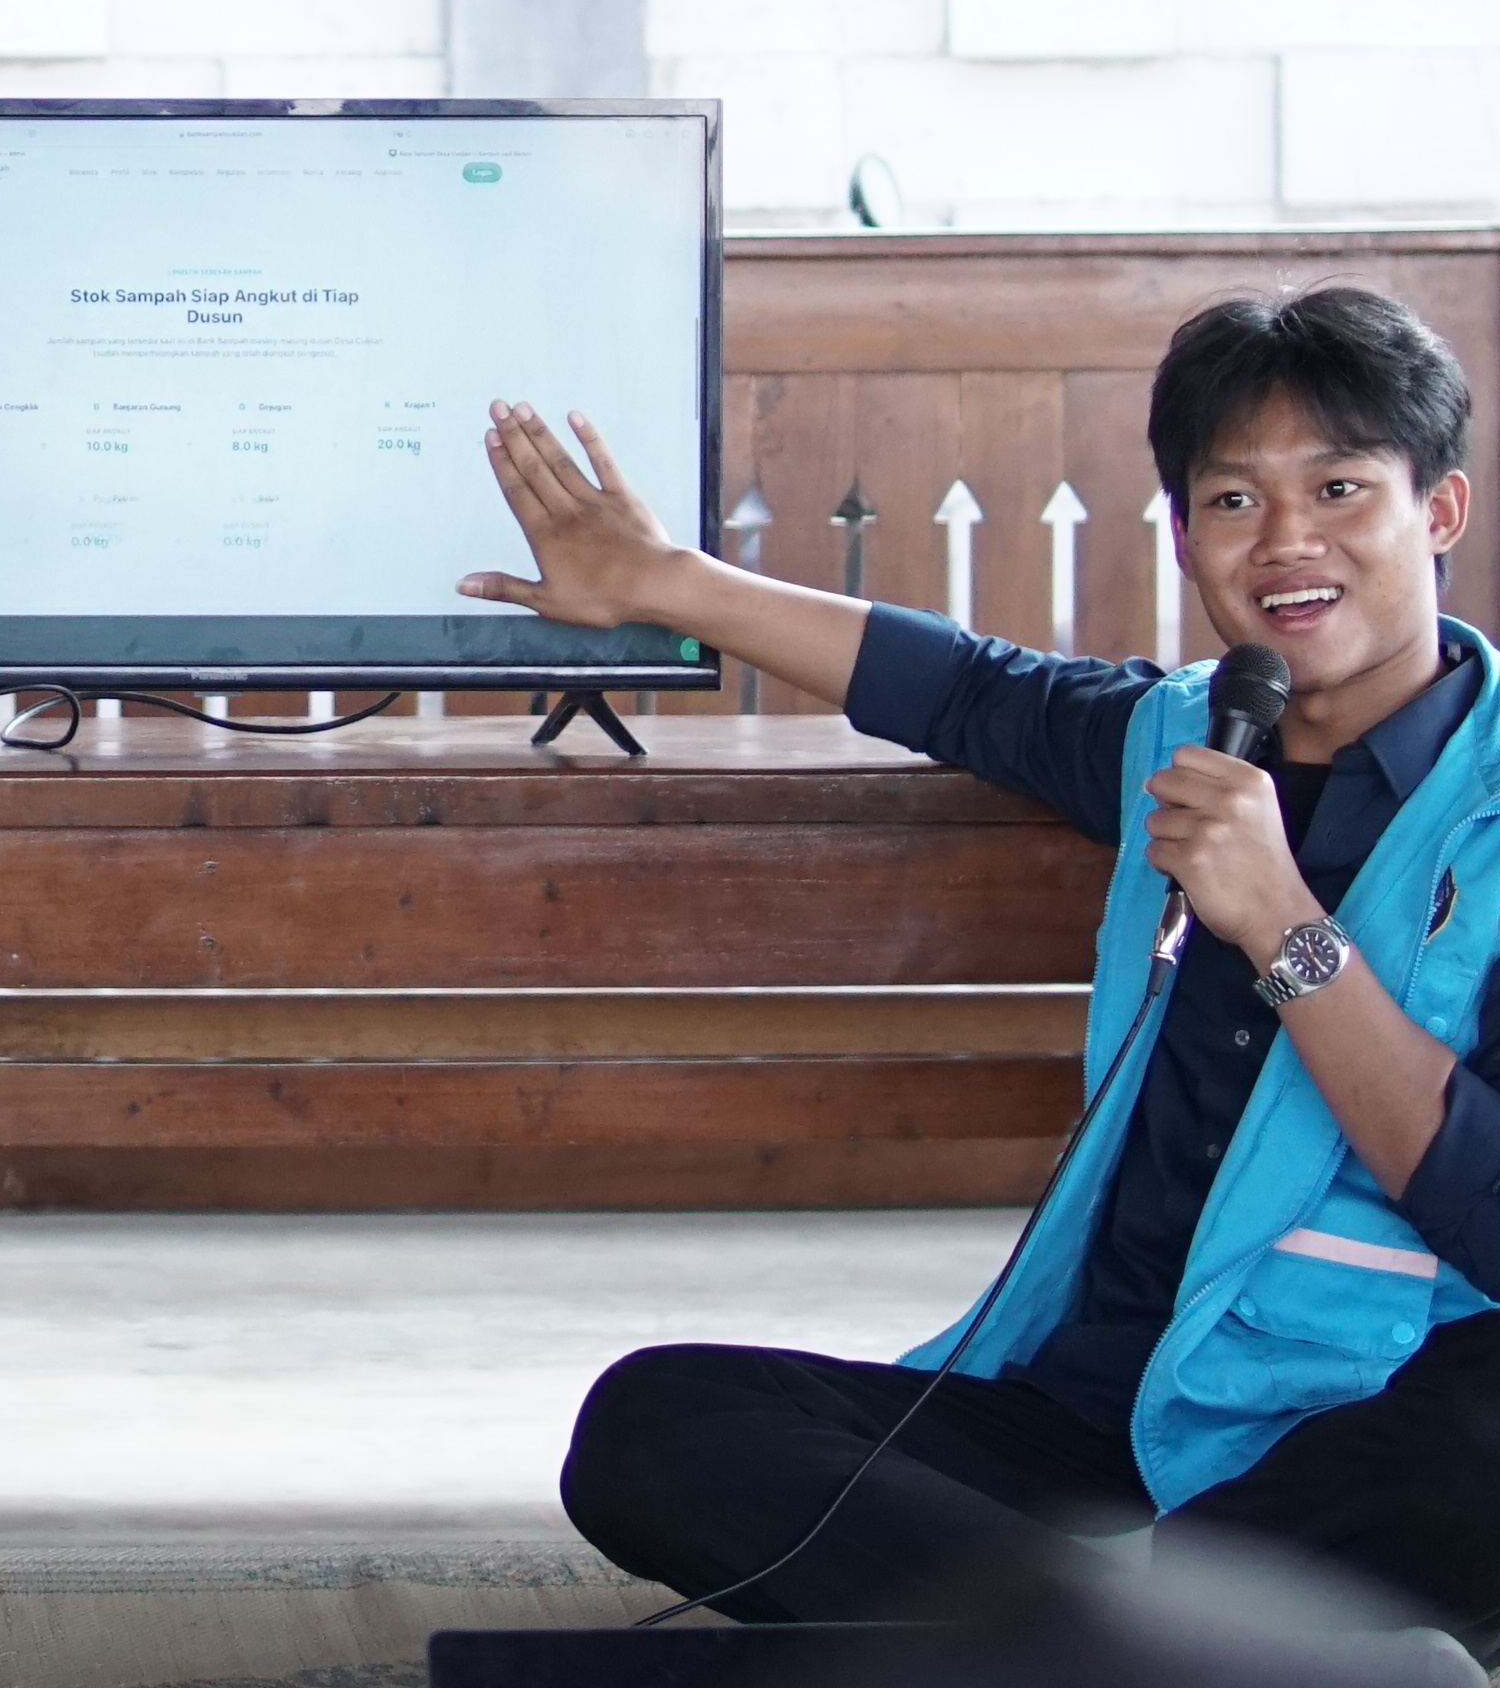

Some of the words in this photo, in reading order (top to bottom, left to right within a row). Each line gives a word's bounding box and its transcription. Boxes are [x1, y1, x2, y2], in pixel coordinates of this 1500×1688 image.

[70, 289, 111, 303] Stok
[115, 289, 187, 306] Sampah
[191, 288, 230, 306] Siap
[234, 289, 298, 306] Angkut
[302, 288, 318, 303] di
[322, 288, 360, 306] Tiap
[187, 309, 243, 324] Dusun
[86, 440, 112, 452] 10.0
[113, 440, 129, 454] kg
[232, 440, 252, 452] 8.0
[253, 440, 269, 454] kg
[377, 438, 405, 450] 20.0
[407, 438, 422, 451] kg
[71, 536, 92, 548] 0.0
[93, 536, 109, 549] kg
[223, 536, 243, 548] 0.0
[246, 536, 261, 549] kg
